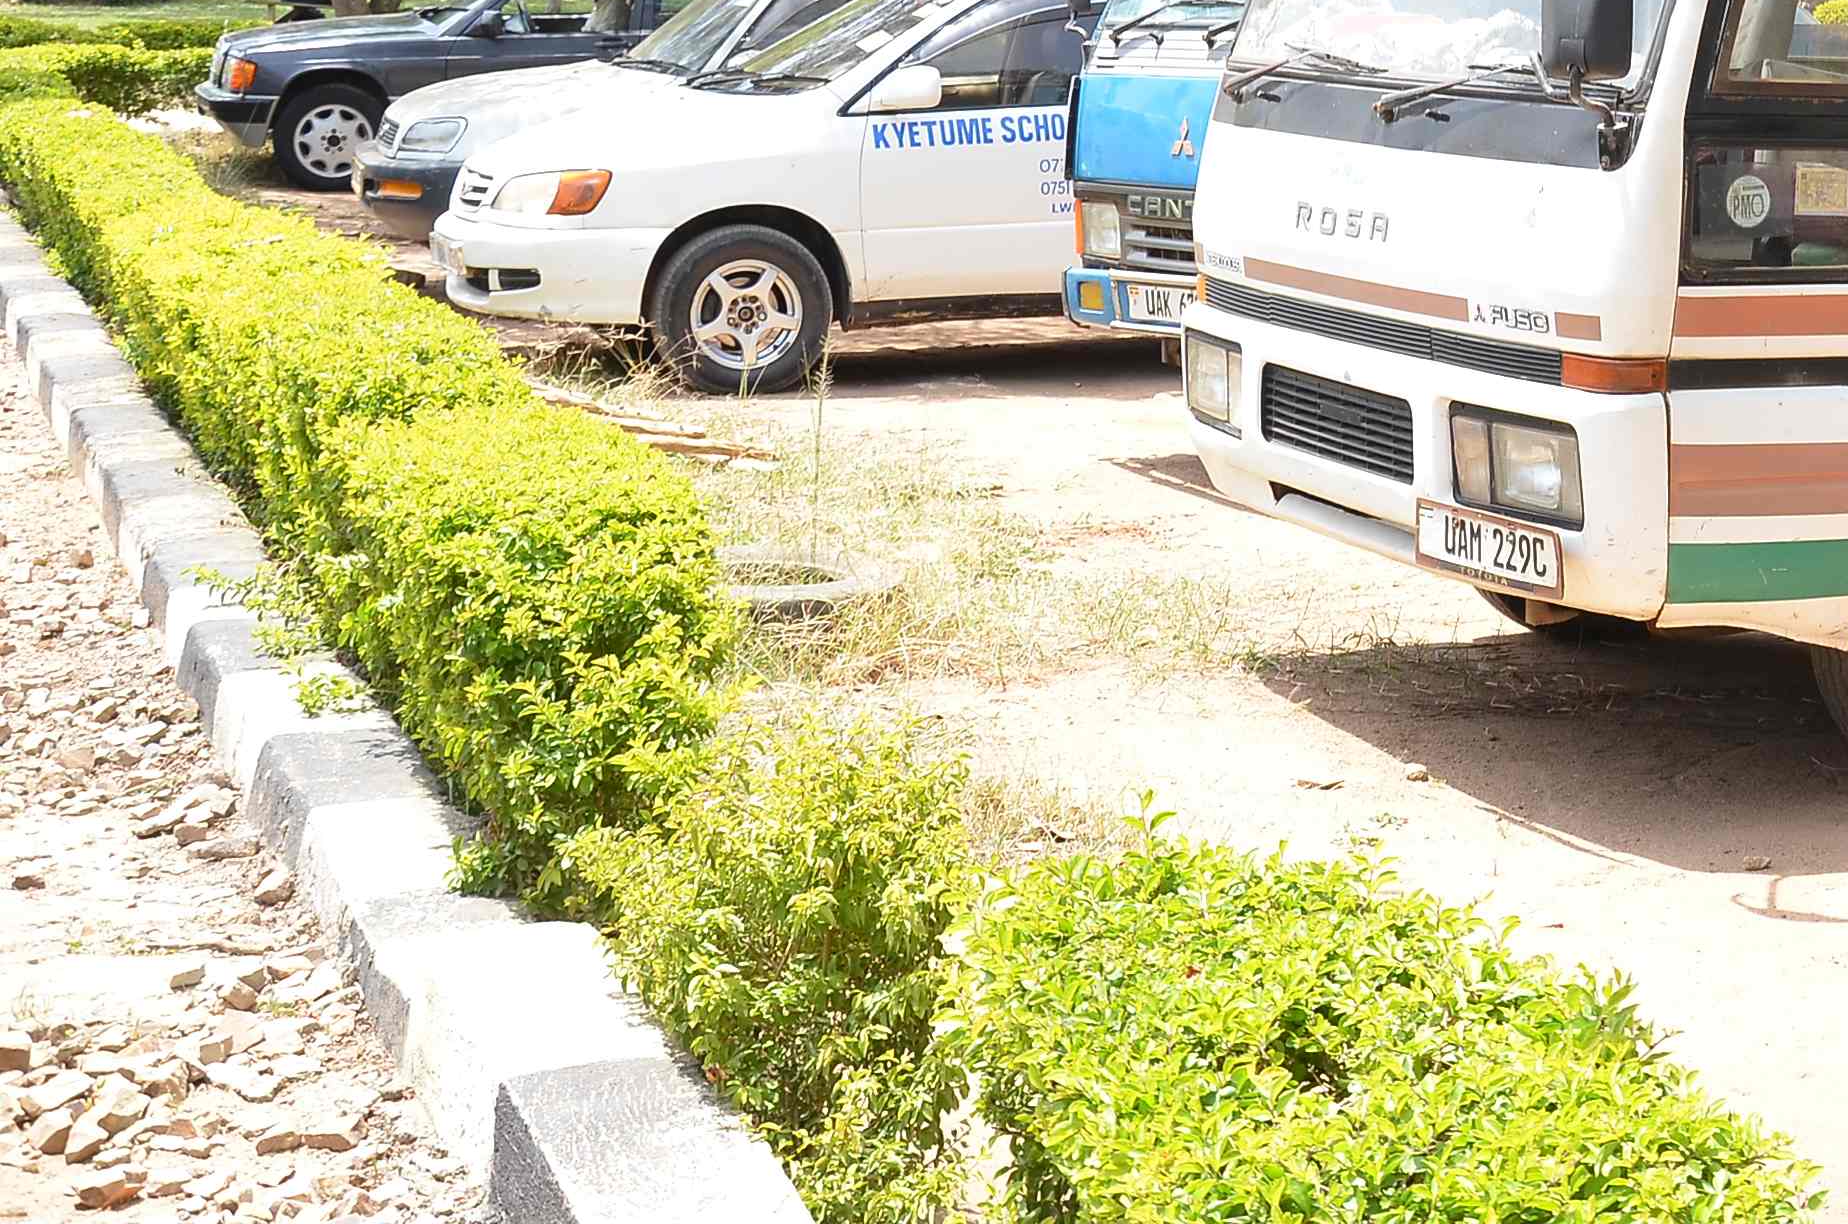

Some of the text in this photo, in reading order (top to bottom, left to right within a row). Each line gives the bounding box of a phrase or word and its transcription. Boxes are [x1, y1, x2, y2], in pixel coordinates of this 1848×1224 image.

[873, 117, 994, 149] KYETUME
[1296, 200, 1389, 243] ROSA
[1145, 288, 1172, 317] UAK
[1488, 304, 1550, 334] FUSO
[1444, 514, 1547, 578] UAM 229C
